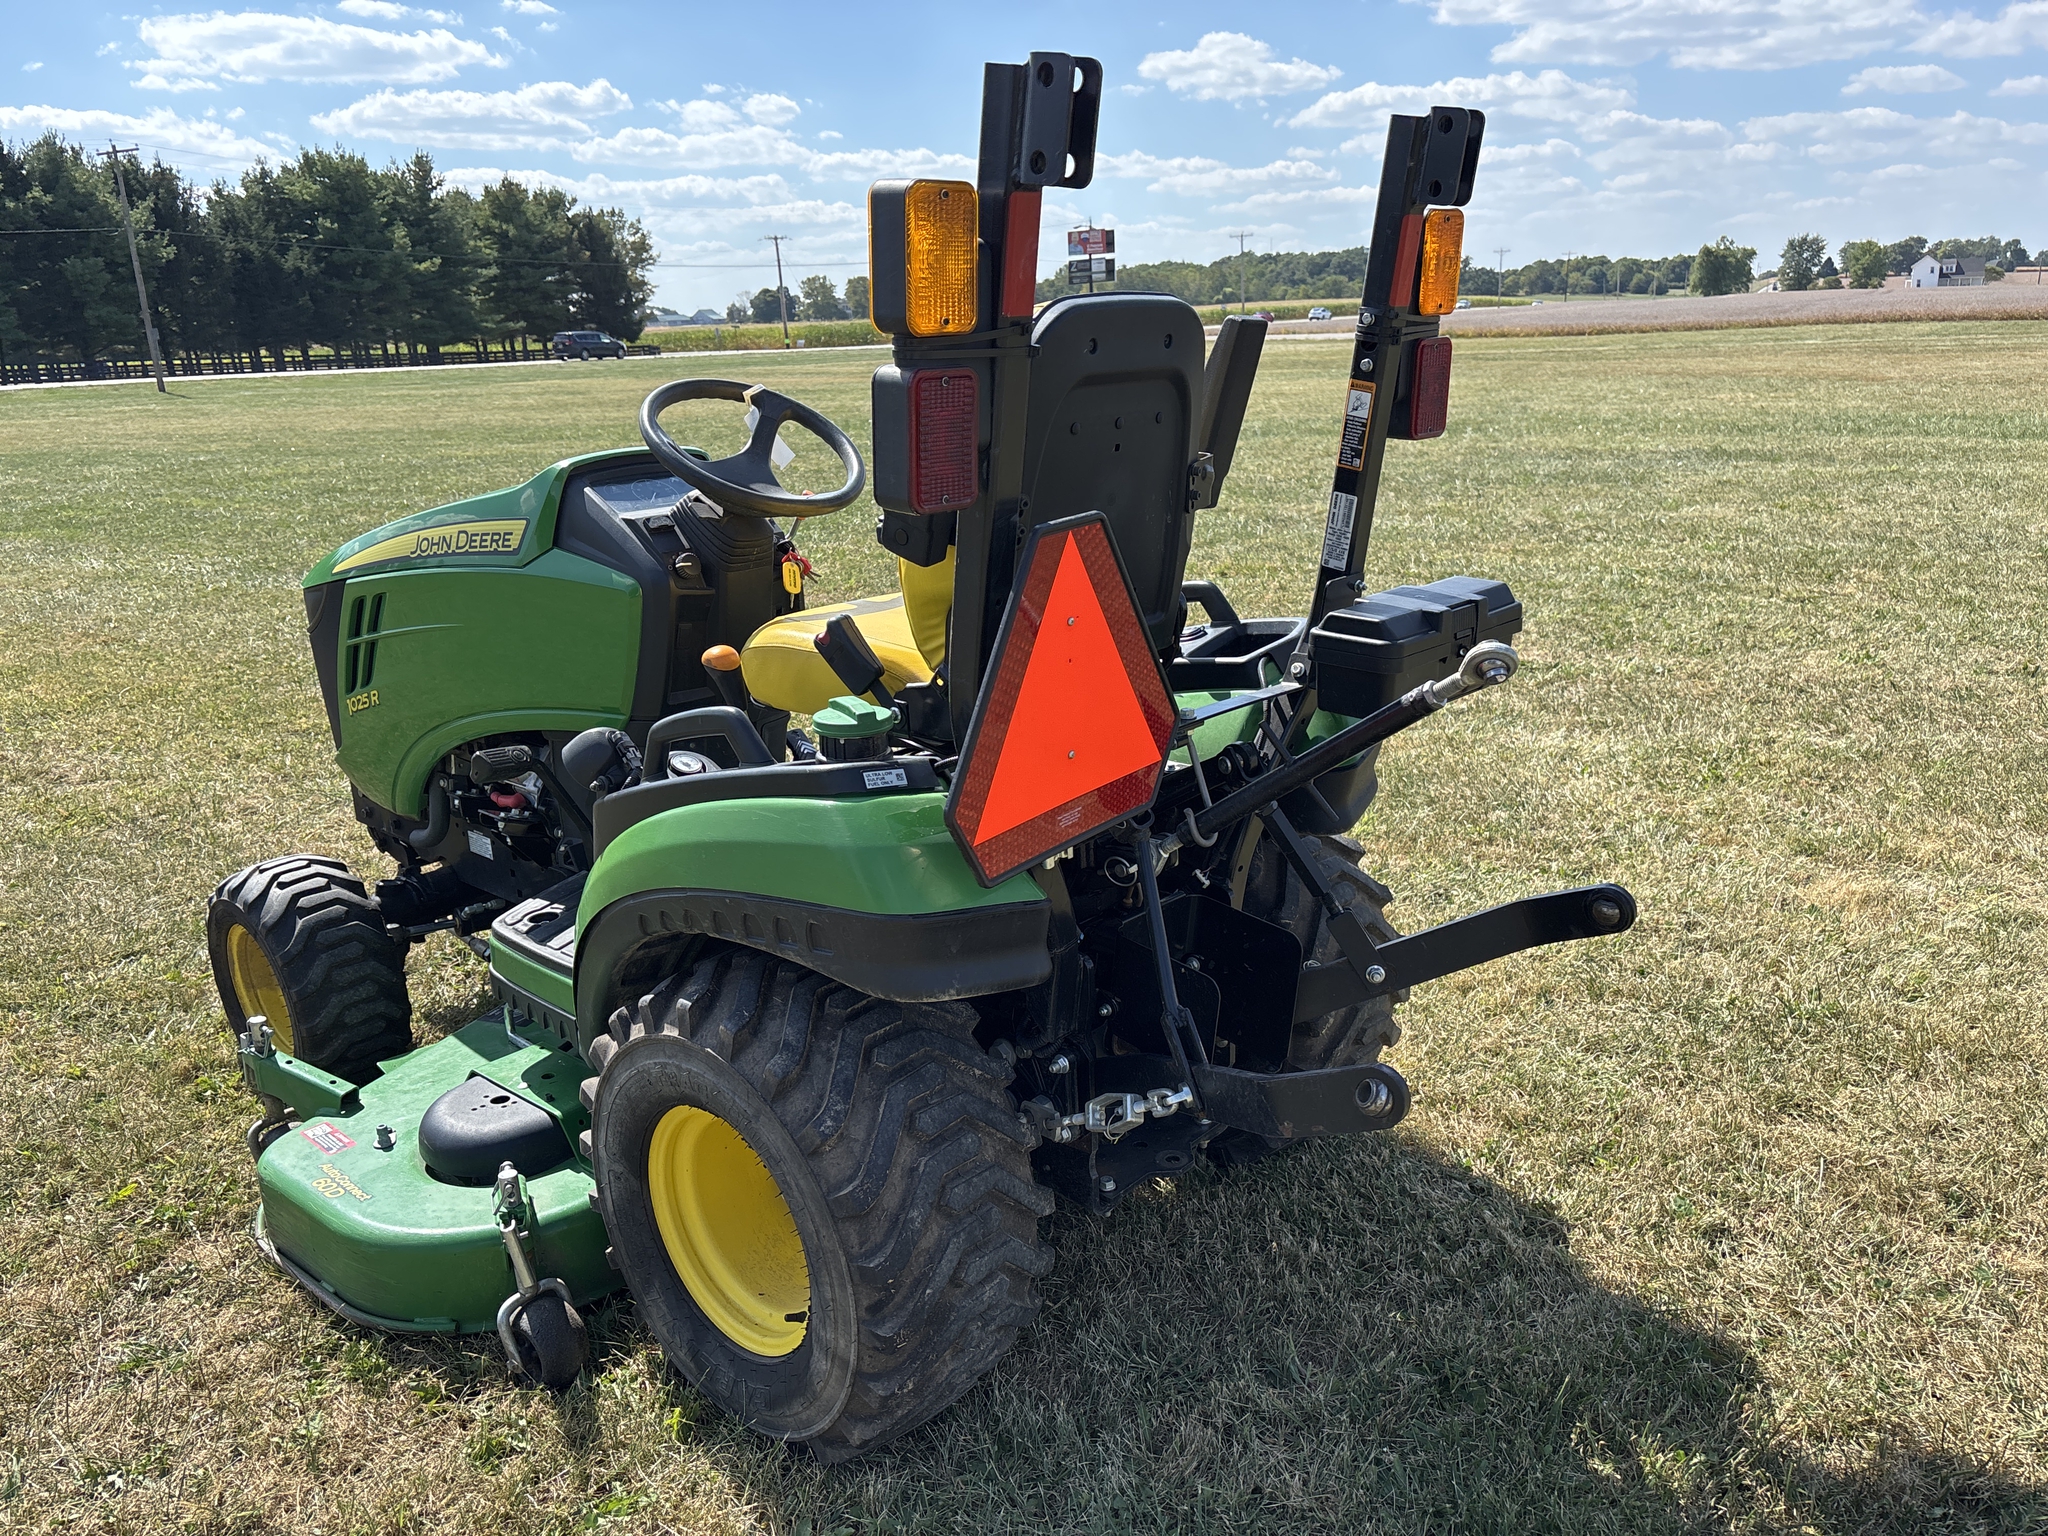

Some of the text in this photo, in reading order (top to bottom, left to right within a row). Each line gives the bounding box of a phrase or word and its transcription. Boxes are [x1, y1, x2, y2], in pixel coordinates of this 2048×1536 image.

[410, 530, 514, 556] JOHN DEERE
[346, 690, 380, 715] 1025 R
[311, 1177, 346, 1198] 60D
[318, 1163, 373, 1202] AutoConnect
